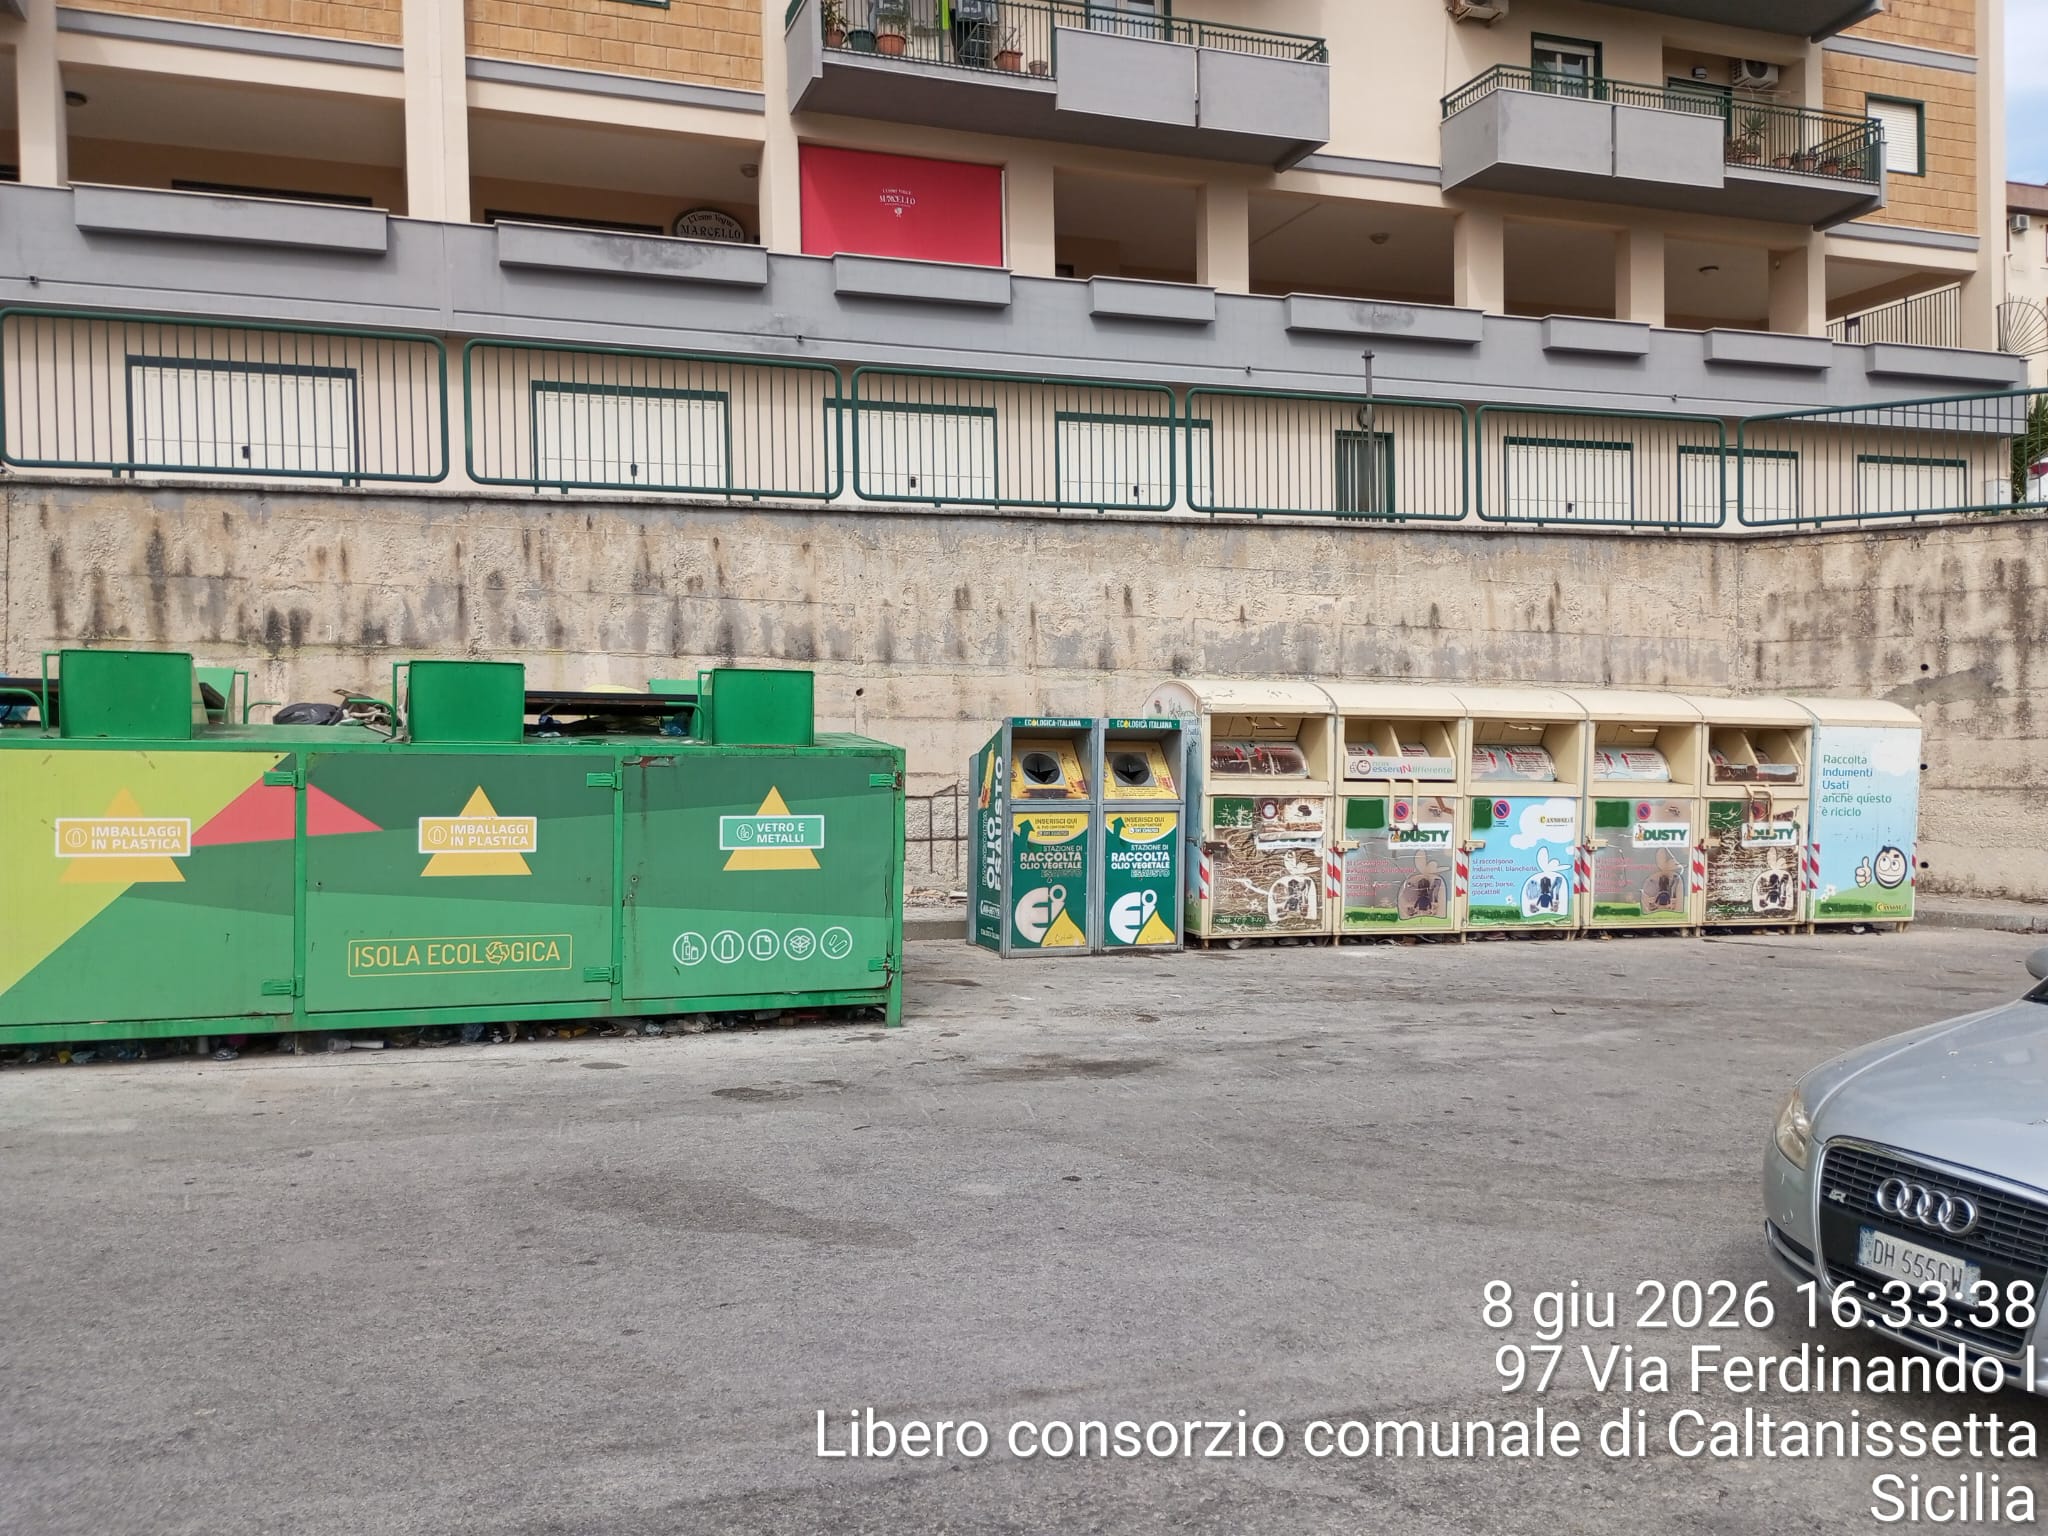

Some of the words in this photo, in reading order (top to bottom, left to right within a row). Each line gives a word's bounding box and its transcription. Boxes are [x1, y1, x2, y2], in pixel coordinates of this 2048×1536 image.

[681, 224, 741, 239] MARCELLO
[1057, 720, 1081, 728] ITALIANA
[1148, 721, 1172, 729] ITALIANA
[1823, 755, 1867, 764] Raccolta
[1822, 768, 1872, 777] Indumenti
[1822, 780, 1849, 789] Usati
[1822, 794, 1853, 802] anche
[1856, 794, 1892, 804] questo
[1822, 807, 1828, 816] è
[1831, 807, 1862, 816] riciclo
[92, 826, 181, 838] IMBALLAGGI
[450, 824, 528, 835] IMBALLAGGI
[756, 822, 794, 832] VETRO
[798, 822, 805, 832] E
[756, 834, 804, 843] METALLI
[1400, 830, 1449, 842] DUSTY
[1643, 830, 1688, 841] DUSTY
[92, 838, 106, 849] IN
[112, 838, 181, 849] PLASTICA
[450, 836, 464, 846] IN
[468, 836, 528, 846] PLASTICA
[986, 816, 996, 889] OLIO
[1020, 852, 1082, 862] RACCOLTA
[1111, 852, 1170, 862] RACCOLTA
[1020, 862, 1040, 870] OLIO
[1042, 862, 1082, 870] VEGETALE
[1111, 862, 1130, 870] OLIO
[1130, 869, 1170, 878] ESAUSTO
[354, 945, 420, 968] ISOLA
[428, 941, 560, 966] ECOLOGICA
[1873, 1239, 1895, 1266] DH
